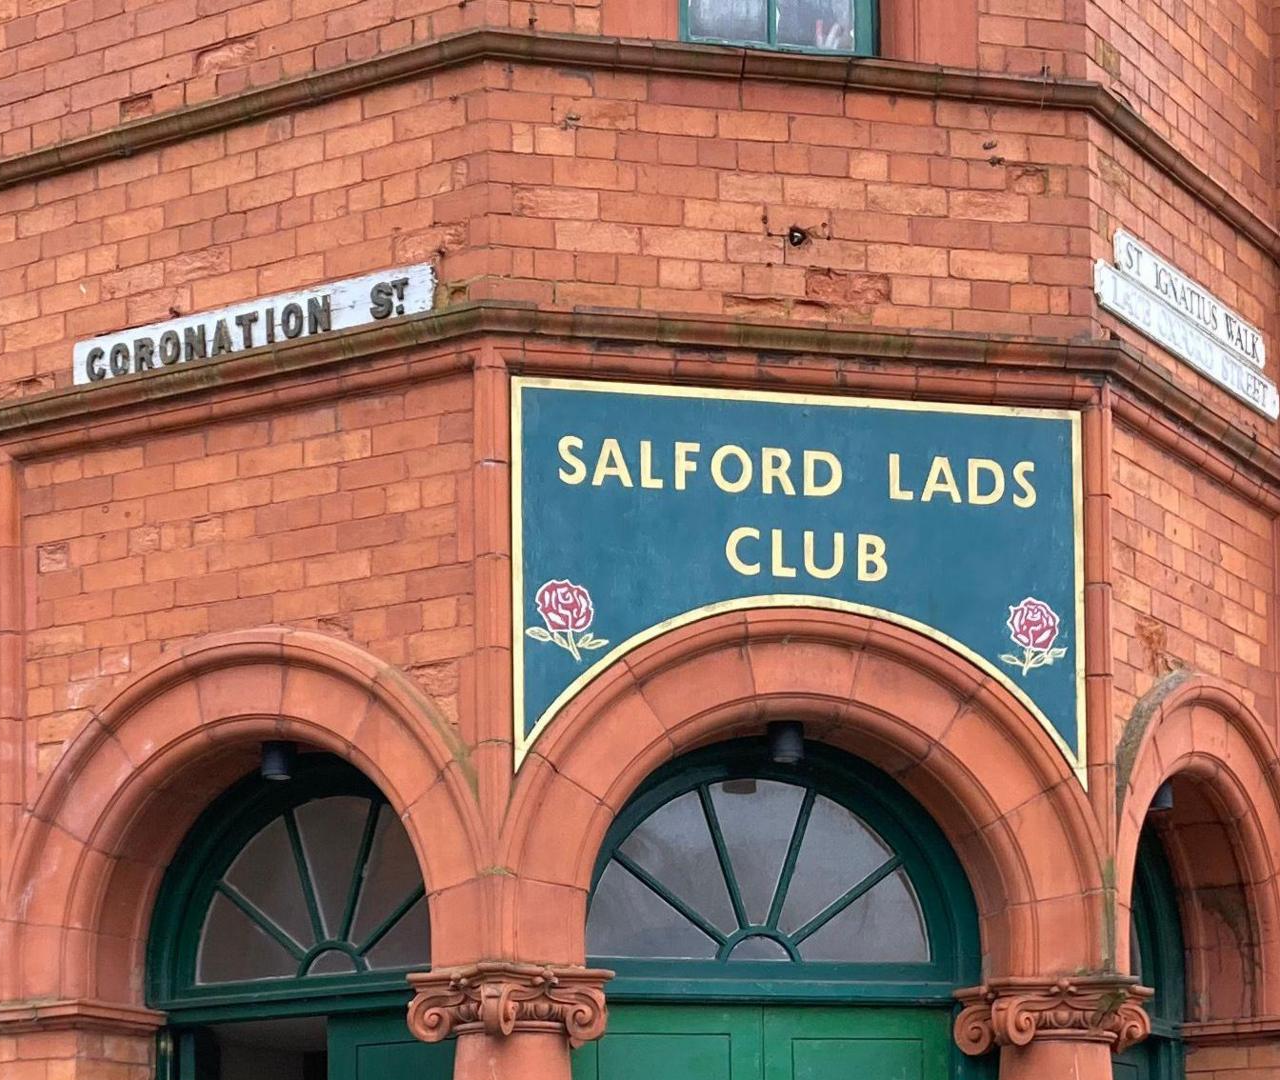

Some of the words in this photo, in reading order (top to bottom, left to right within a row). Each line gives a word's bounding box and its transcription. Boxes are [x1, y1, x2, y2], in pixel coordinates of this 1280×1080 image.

[85, 294, 332, 382] CORONATION
[1125, 241, 1142, 278] ST
[1153, 263, 1218, 333] IGNATIUS
[1224, 312, 1260, 364] WALK
[557, 434, 843, 498] SALFORD
[887, 451, 1038, 509] LADS
[724, 526, 889, 582] CLUB
